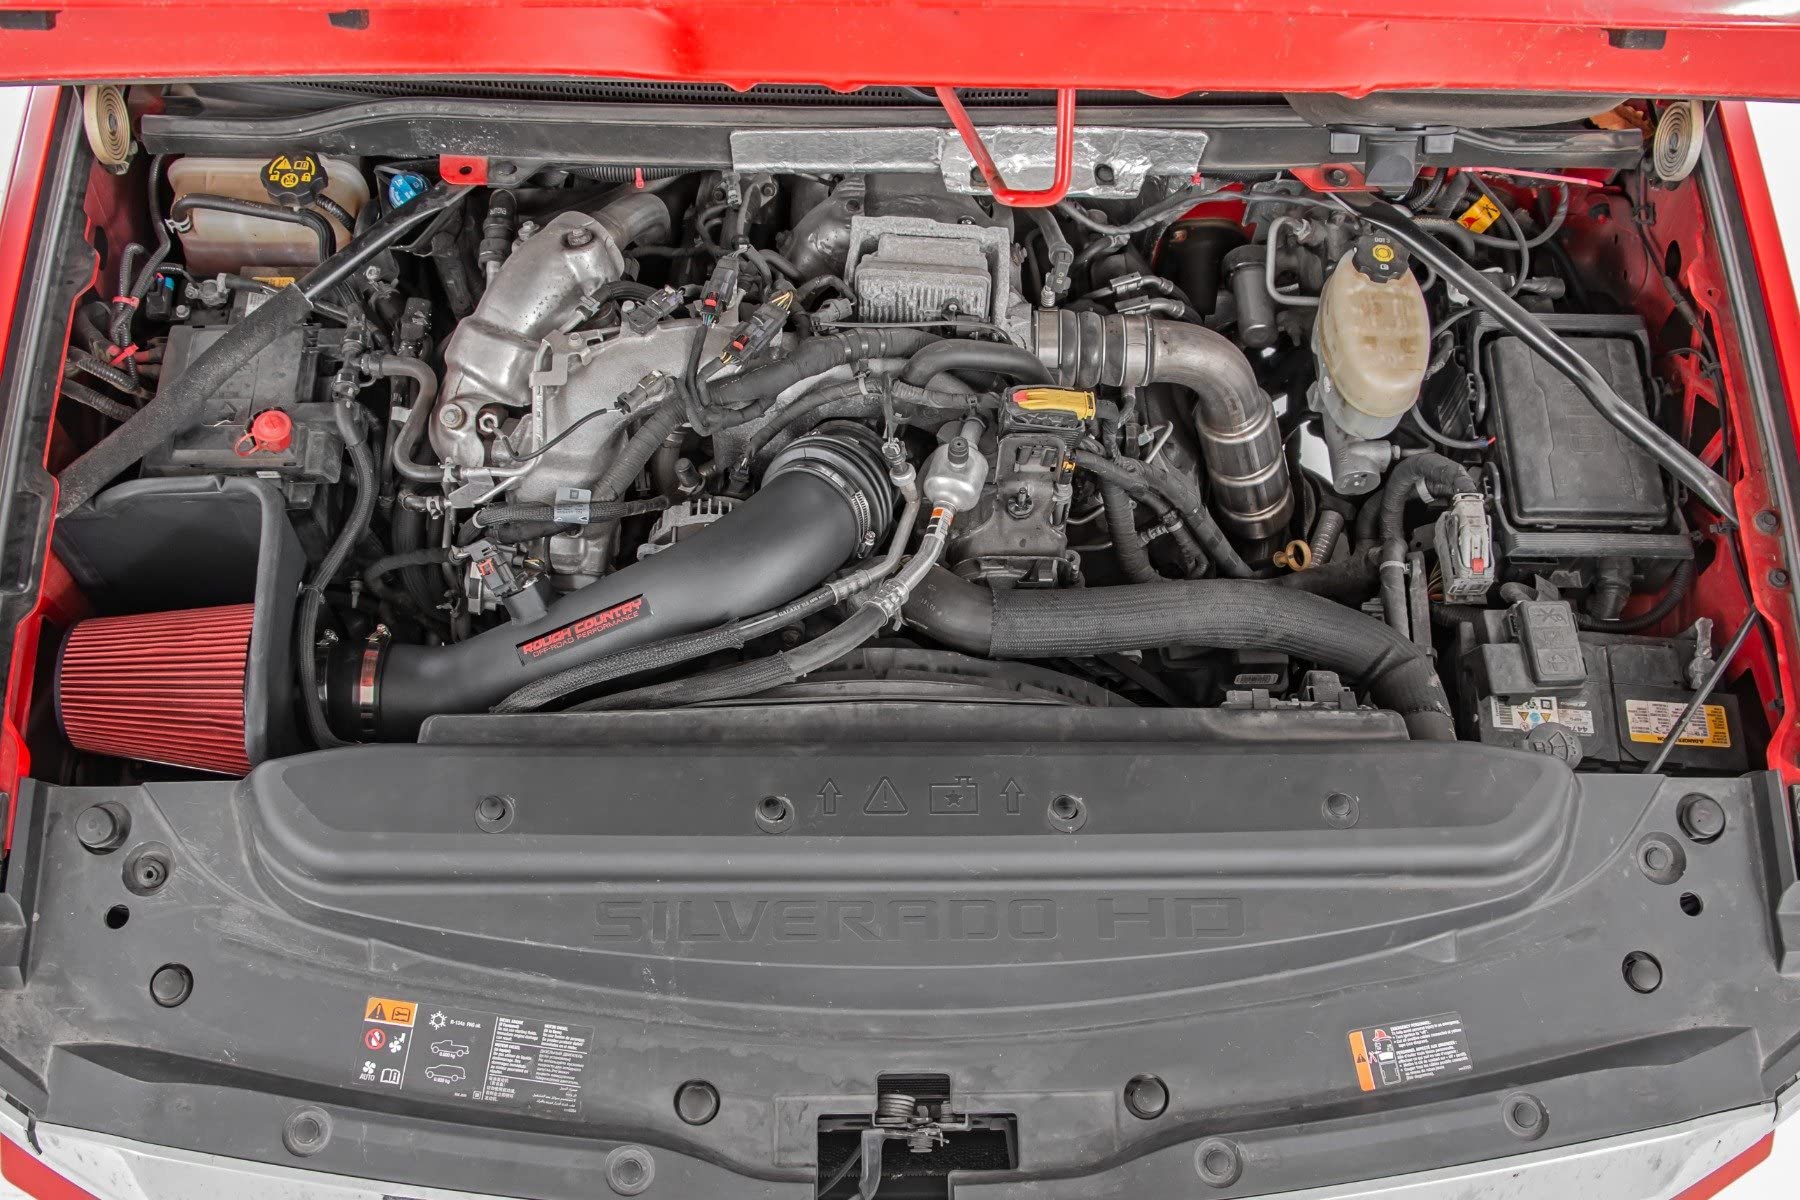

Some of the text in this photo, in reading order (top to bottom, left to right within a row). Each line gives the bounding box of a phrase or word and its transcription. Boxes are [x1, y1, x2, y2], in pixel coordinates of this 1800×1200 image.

[523, 598, 642, 654] ROUGH COUNTRY
[779, 604, 800, 617] GALAXY
[533, 610, 639, 657] OFF-ROAD PERFORMANCE
[593, 898, 1246, 943] SILVERADO HD
[359, 1073, 376, 1081] AUTO
